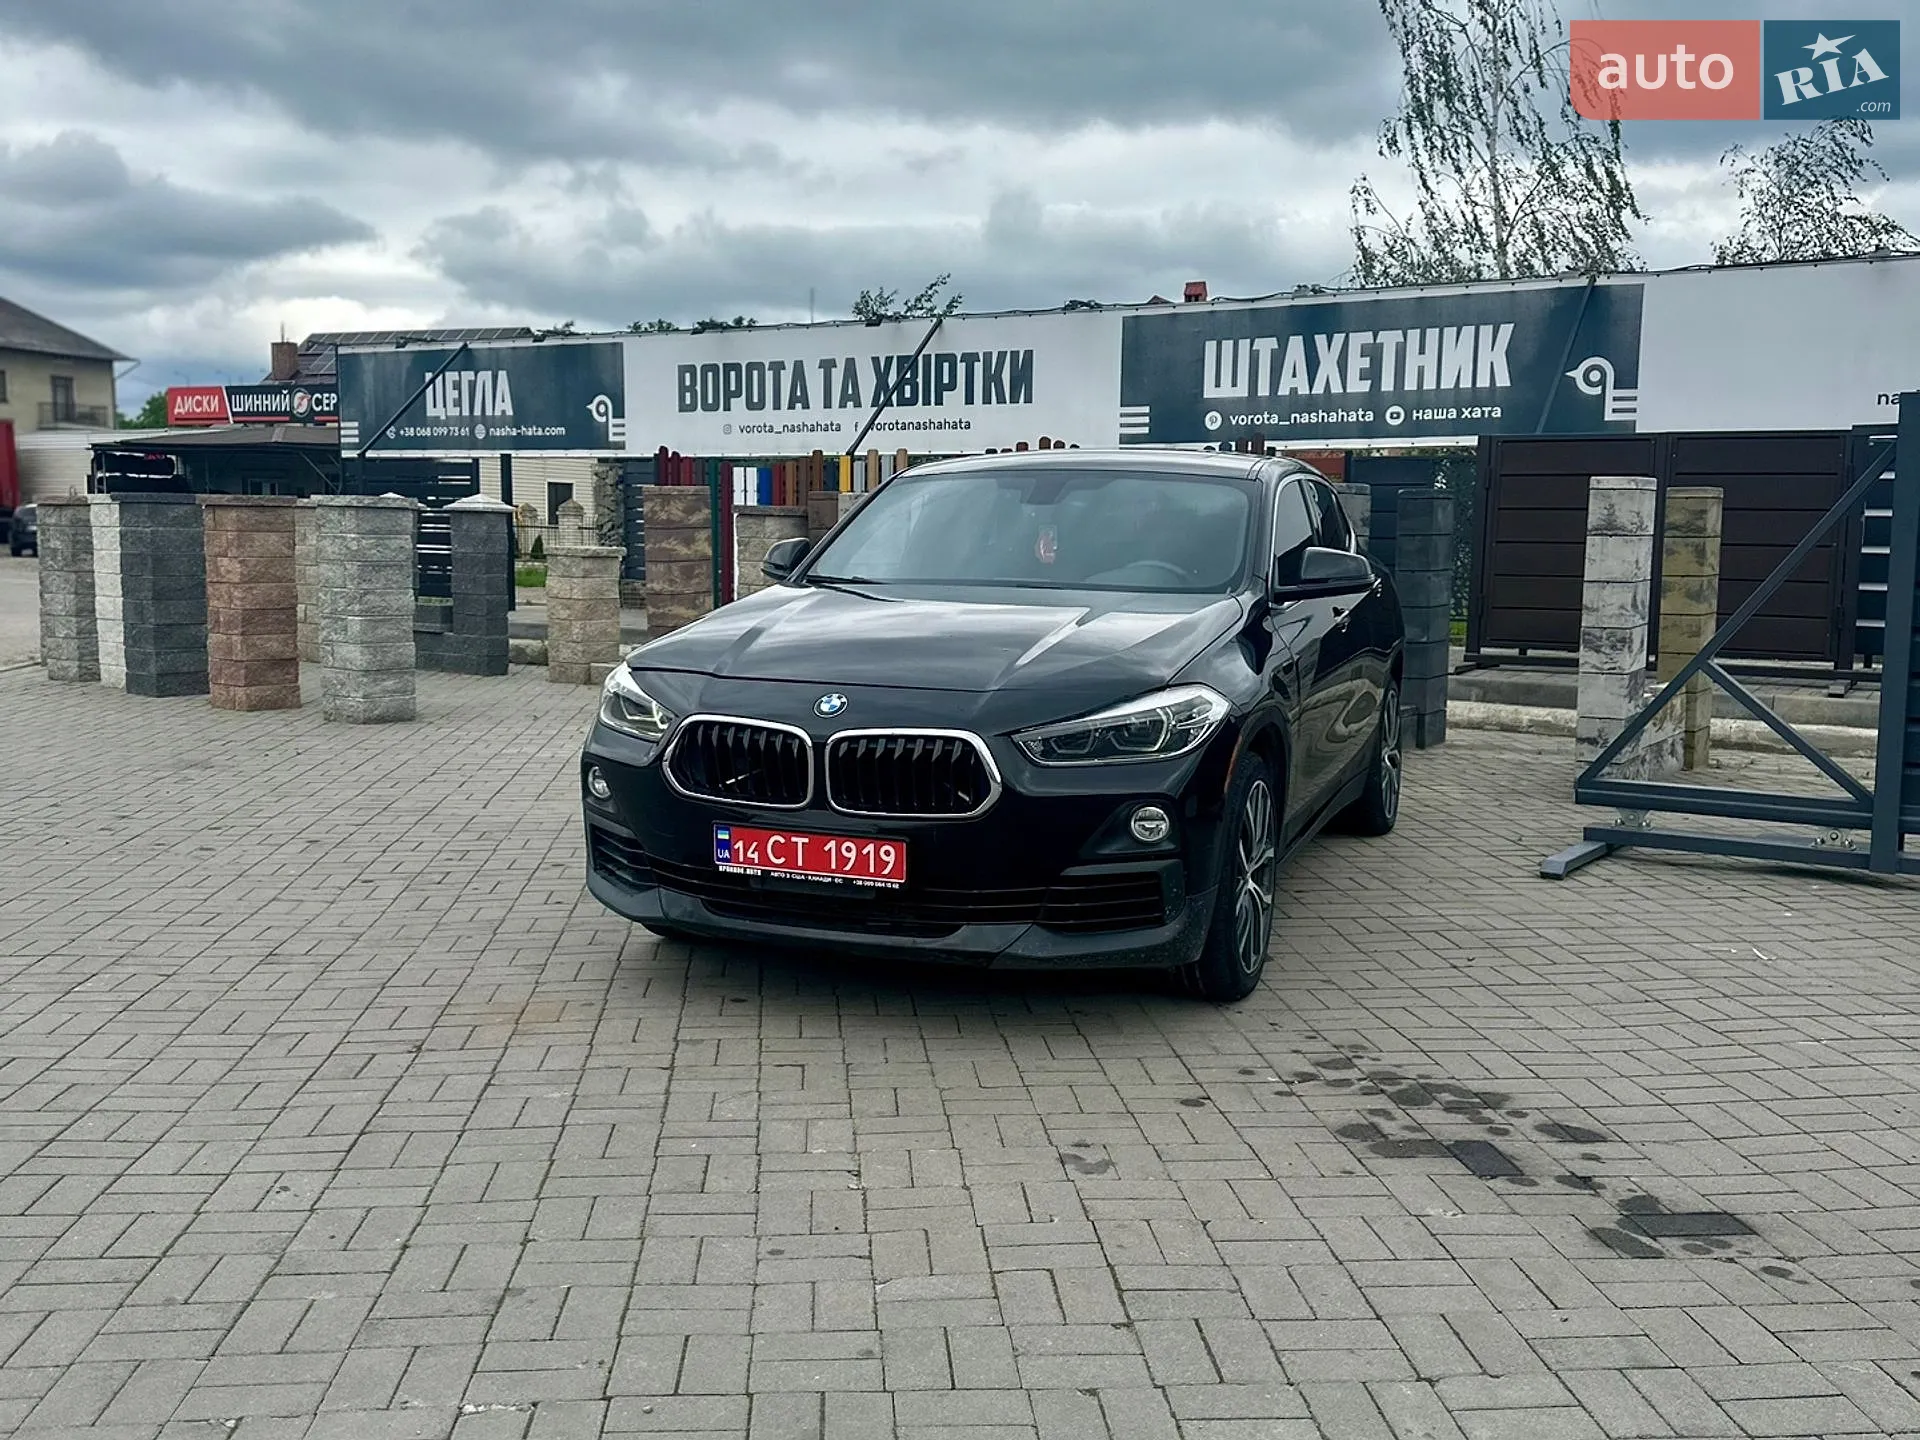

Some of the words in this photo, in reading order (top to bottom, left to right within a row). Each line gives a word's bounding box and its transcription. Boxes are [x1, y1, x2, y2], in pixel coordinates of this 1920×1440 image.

[1203, 323, 1515, 398] ШТАХЕТНИК
[677, 359, 811, 413] ВОРОТА
[818, 357, 862, 409] ТА
[870, 350, 1034, 408] ХВІРТКИ
[174, 395, 219, 415] ДИСКИ
[231, 389, 290, 412] ШИННИЙ
[424, 370, 514, 420] ЦЕГЛА
[1229, 408, 1374, 426] vorota_nashahata
[1412, 407, 1456, 421] наша
[1461, 405, 1502, 419] хата
[489, 425, 566, 436] nasha-hata.com
[738, 420, 842, 435] vorota_nashahata
[717, 847, 730, 859] UA
[733, 840, 760, 864] 14
[823, 839, 896, 875] 1919
